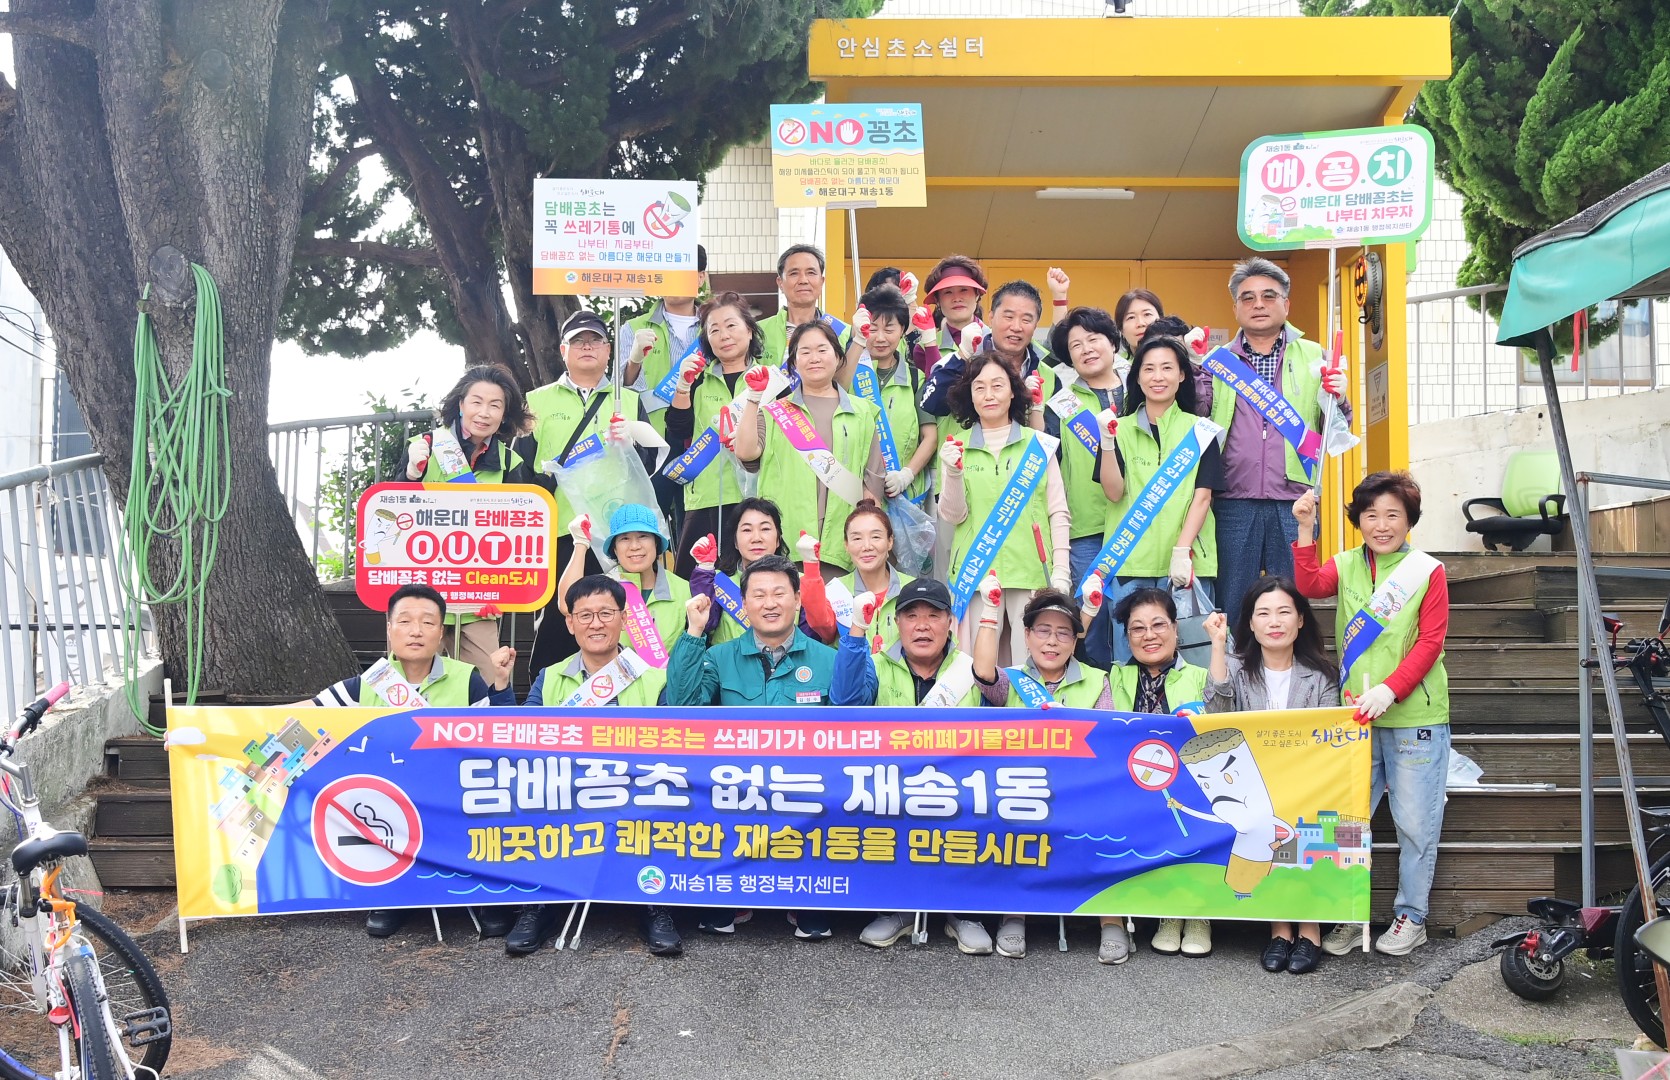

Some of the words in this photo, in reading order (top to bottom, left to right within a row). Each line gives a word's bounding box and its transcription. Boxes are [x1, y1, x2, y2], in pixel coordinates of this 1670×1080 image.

[837, 36, 984, 58] 안심초소쉼터
[810, 118, 864, 146] NO
[866, 120, 918, 144] 꽁초
[1265, 144, 1291, 153] 재송1동
[810, 158, 832, 166] 바다로
[800, 177, 828, 185] 담배꽁초
[848, 177, 875, 185] 아름다운
[818, 187, 856, 196] 해운대구
[860, 187, 894, 196] 재송1동
[544, 201, 616, 217] 담배꽁초는
[1300, 195, 1340, 209] 해운대
[1346, 190, 1413, 206] 담배꽁초는
[1326, 208, 1366, 223] 나부터
[1371, 205, 1413, 220] 치우자
[544, 220, 558, 234] 꼭
[564, 220, 635, 236] 쓰레기통에
[578, 240, 608, 249] 나부터!
[614, 240, 654, 249] 지금부터!
[540, 251, 575, 261] 담배꽁초
[579, 252, 595, 261] 없는
[598, 252, 633, 262] 아름다운
[636, 252, 662, 262] 해운대
[665, 253, 691, 262] 만들기
[581, 272, 622, 283] 해운대구
[626, 273, 663, 283] 재송1동
[1207, 359, 1238, 383] 쓰레기와
[1234, 380, 1269, 410] 담배꽁초
[1265, 406, 1287, 427] 없는
[1250, 378, 1278, 403] 깨끗한
[682, 434, 713, 466] 쓰레기와
[1018, 452, 1044, 490] 담배꽁초
[1164, 447, 1195, 480] 쓰레기와
[380, 496, 407, 504] 재송1동
[1140, 476, 1173, 512] 담배꽁초
[997, 487, 1025, 526] 안버리기
[416, 509, 469, 527] 해운대
[474, 510, 544, 527] 담배꽁초
[1128, 509, 1147, 531] 없는
[976, 524, 1003, 556] 나부터
[1110, 528, 1136, 558] 깨끗한
[368, 570, 427, 586] 담배꽁초
[432, 570, 461, 586] 없는
[465, 571, 538, 586] Clean도시
[957, 554, 984, 595] 지금부터
[450, 592, 500, 600] 행정복지센터
[626, 618, 648, 649] 안버리기
[632, 604, 650, 630] 나부터
[643, 628, 665, 660] 지금부터
[1018, 676, 1048, 707] 쓰레기와
[433, 722, 484, 743] NO!
[492, 723, 583, 746] 담배꽁초
[592, 725, 706, 749] 담배꽁초는
[713, 728, 805, 750] 쓰레기가
[812, 728, 882, 750] 아니라
[888, 728, 1073, 750] 유해폐기물입니다
[1256, 730, 1270, 738] 살기
[1272, 730, 1286, 738] 좋은
[459, 756, 690, 814] 담배꽁초
[710, 764, 825, 814] 없는
[842, 764, 1051, 821] 재송1동
[467, 821, 605, 862] 깨끗하고
[615, 820, 724, 860] 쾌적한
[732, 824, 896, 862] 재송1동을
[908, 828, 1052, 866] 만듭시다
[669, 872, 733, 893] 재송1동
[739, 874, 850, 895] 행정복지센터
